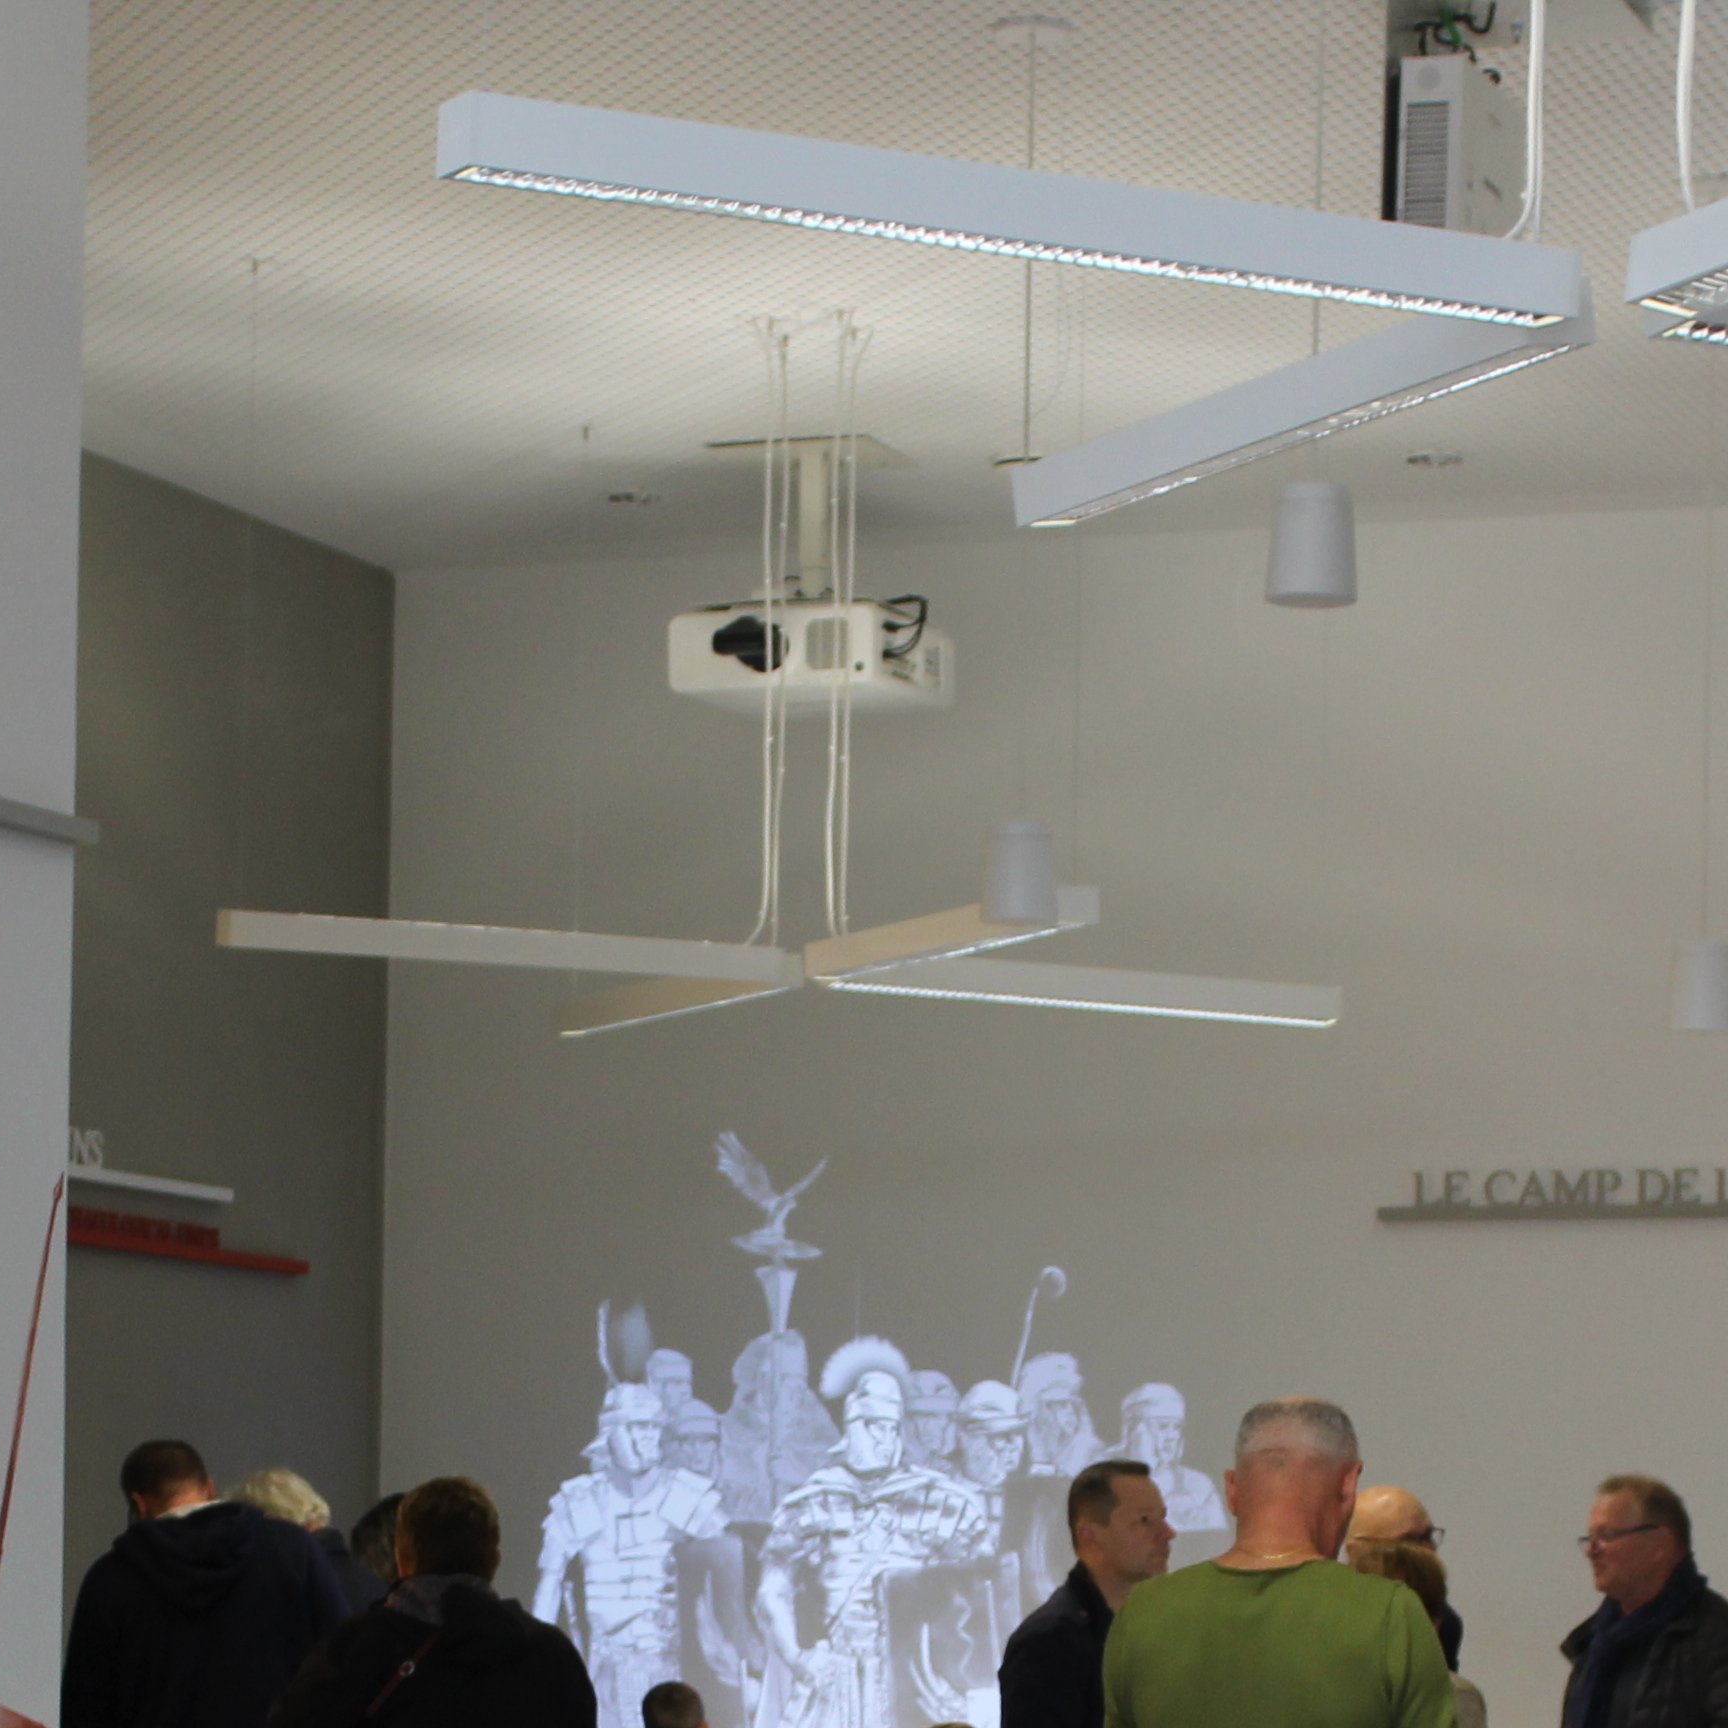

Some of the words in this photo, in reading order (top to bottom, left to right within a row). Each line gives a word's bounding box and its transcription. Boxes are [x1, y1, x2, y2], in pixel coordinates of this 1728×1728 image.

[1412, 1169, 1472, 1206] LE
[1483, 1168, 1623, 1205] CAMP
[1634, 1167, 1700, 1204] DE
